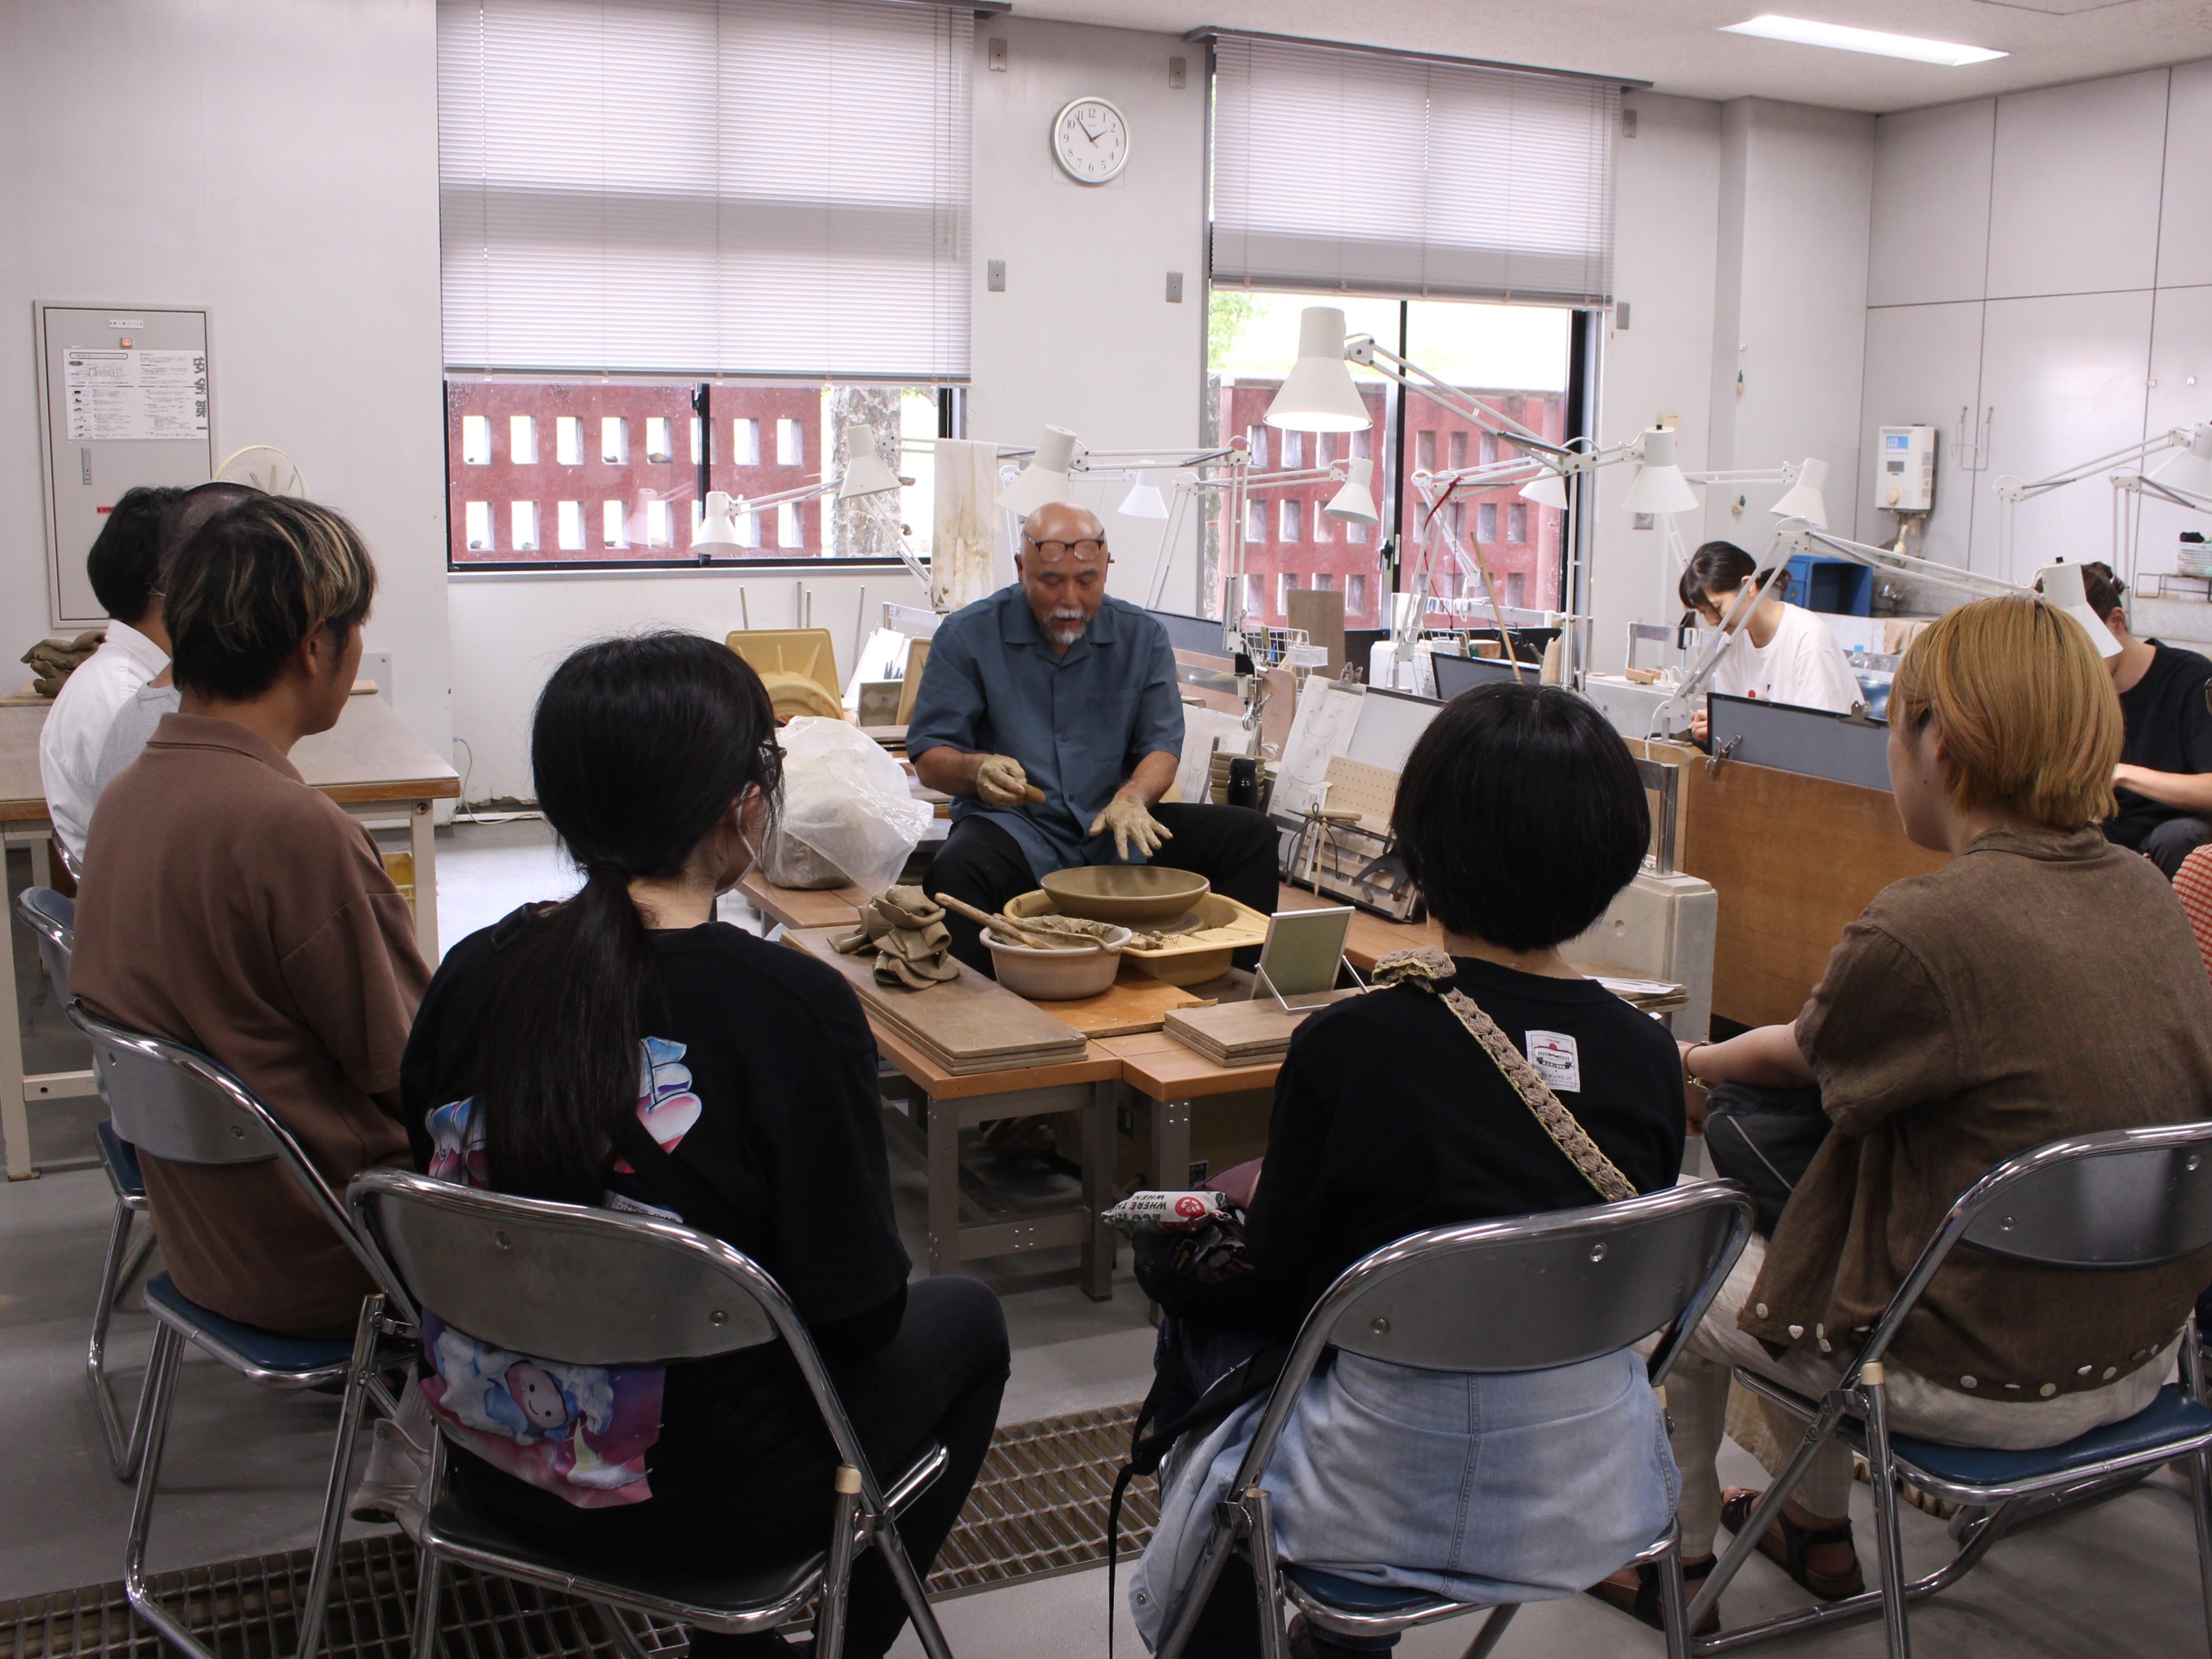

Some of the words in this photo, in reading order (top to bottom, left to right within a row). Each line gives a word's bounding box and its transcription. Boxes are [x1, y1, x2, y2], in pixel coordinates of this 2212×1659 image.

[1078, 110, 1083, 120] 11
[1088, 108, 1096, 118] 12
[1103, 112, 1106, 122] 1
[1067, 119, 1075, 129] 10
[1110, 123, 1116, 133] 2
[1064, 133, 1069, 143] 9
[1114, 138, 1119, 147] 3
[1068, 148, 1073, 157] 8
[1109, 152, 1114, 161] 4
[1077, 159, 1082, 168] 7
[1088, 162, 1094, 172] 6
[1101, 160, 1106, 169] 5
[193, 356, 208, 430] 安全第一
